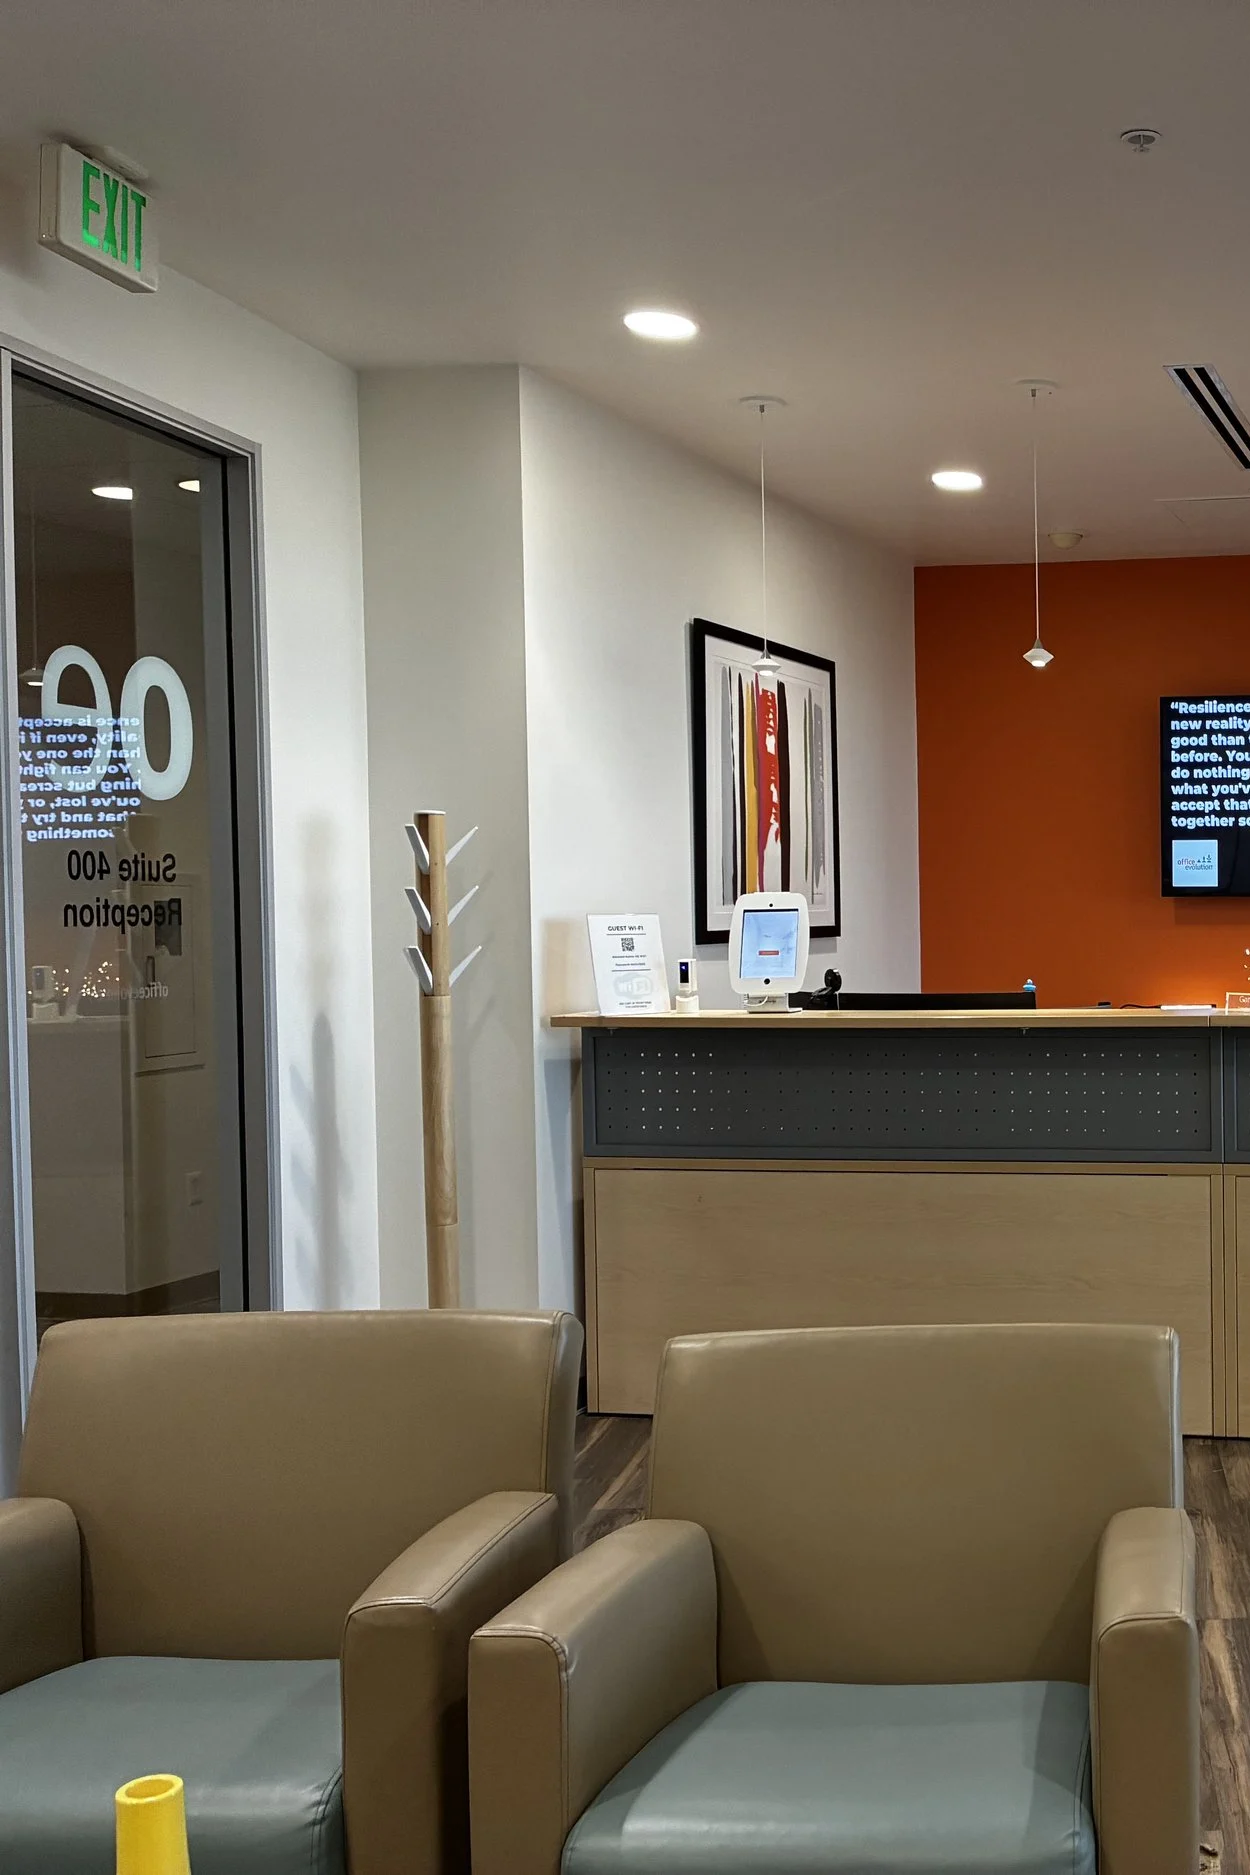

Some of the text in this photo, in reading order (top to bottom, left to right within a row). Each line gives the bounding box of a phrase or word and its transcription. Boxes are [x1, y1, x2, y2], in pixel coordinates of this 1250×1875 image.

[82, 160, 147, 273] EXIT
[1170, 720, 1202, 730] new
[1170, 733, 1208, 749] good
[1210, 733, 1245, 746] than
[1170, 750, 1223, 763] before.
[1170, 766, 1190, 779] do
[1193, 764, 1250, 780] nothing
[1170, 782, 1208, 795] what
[1171, 799, 1221, 813] accept
[1171, 814, 1236, 830] together
